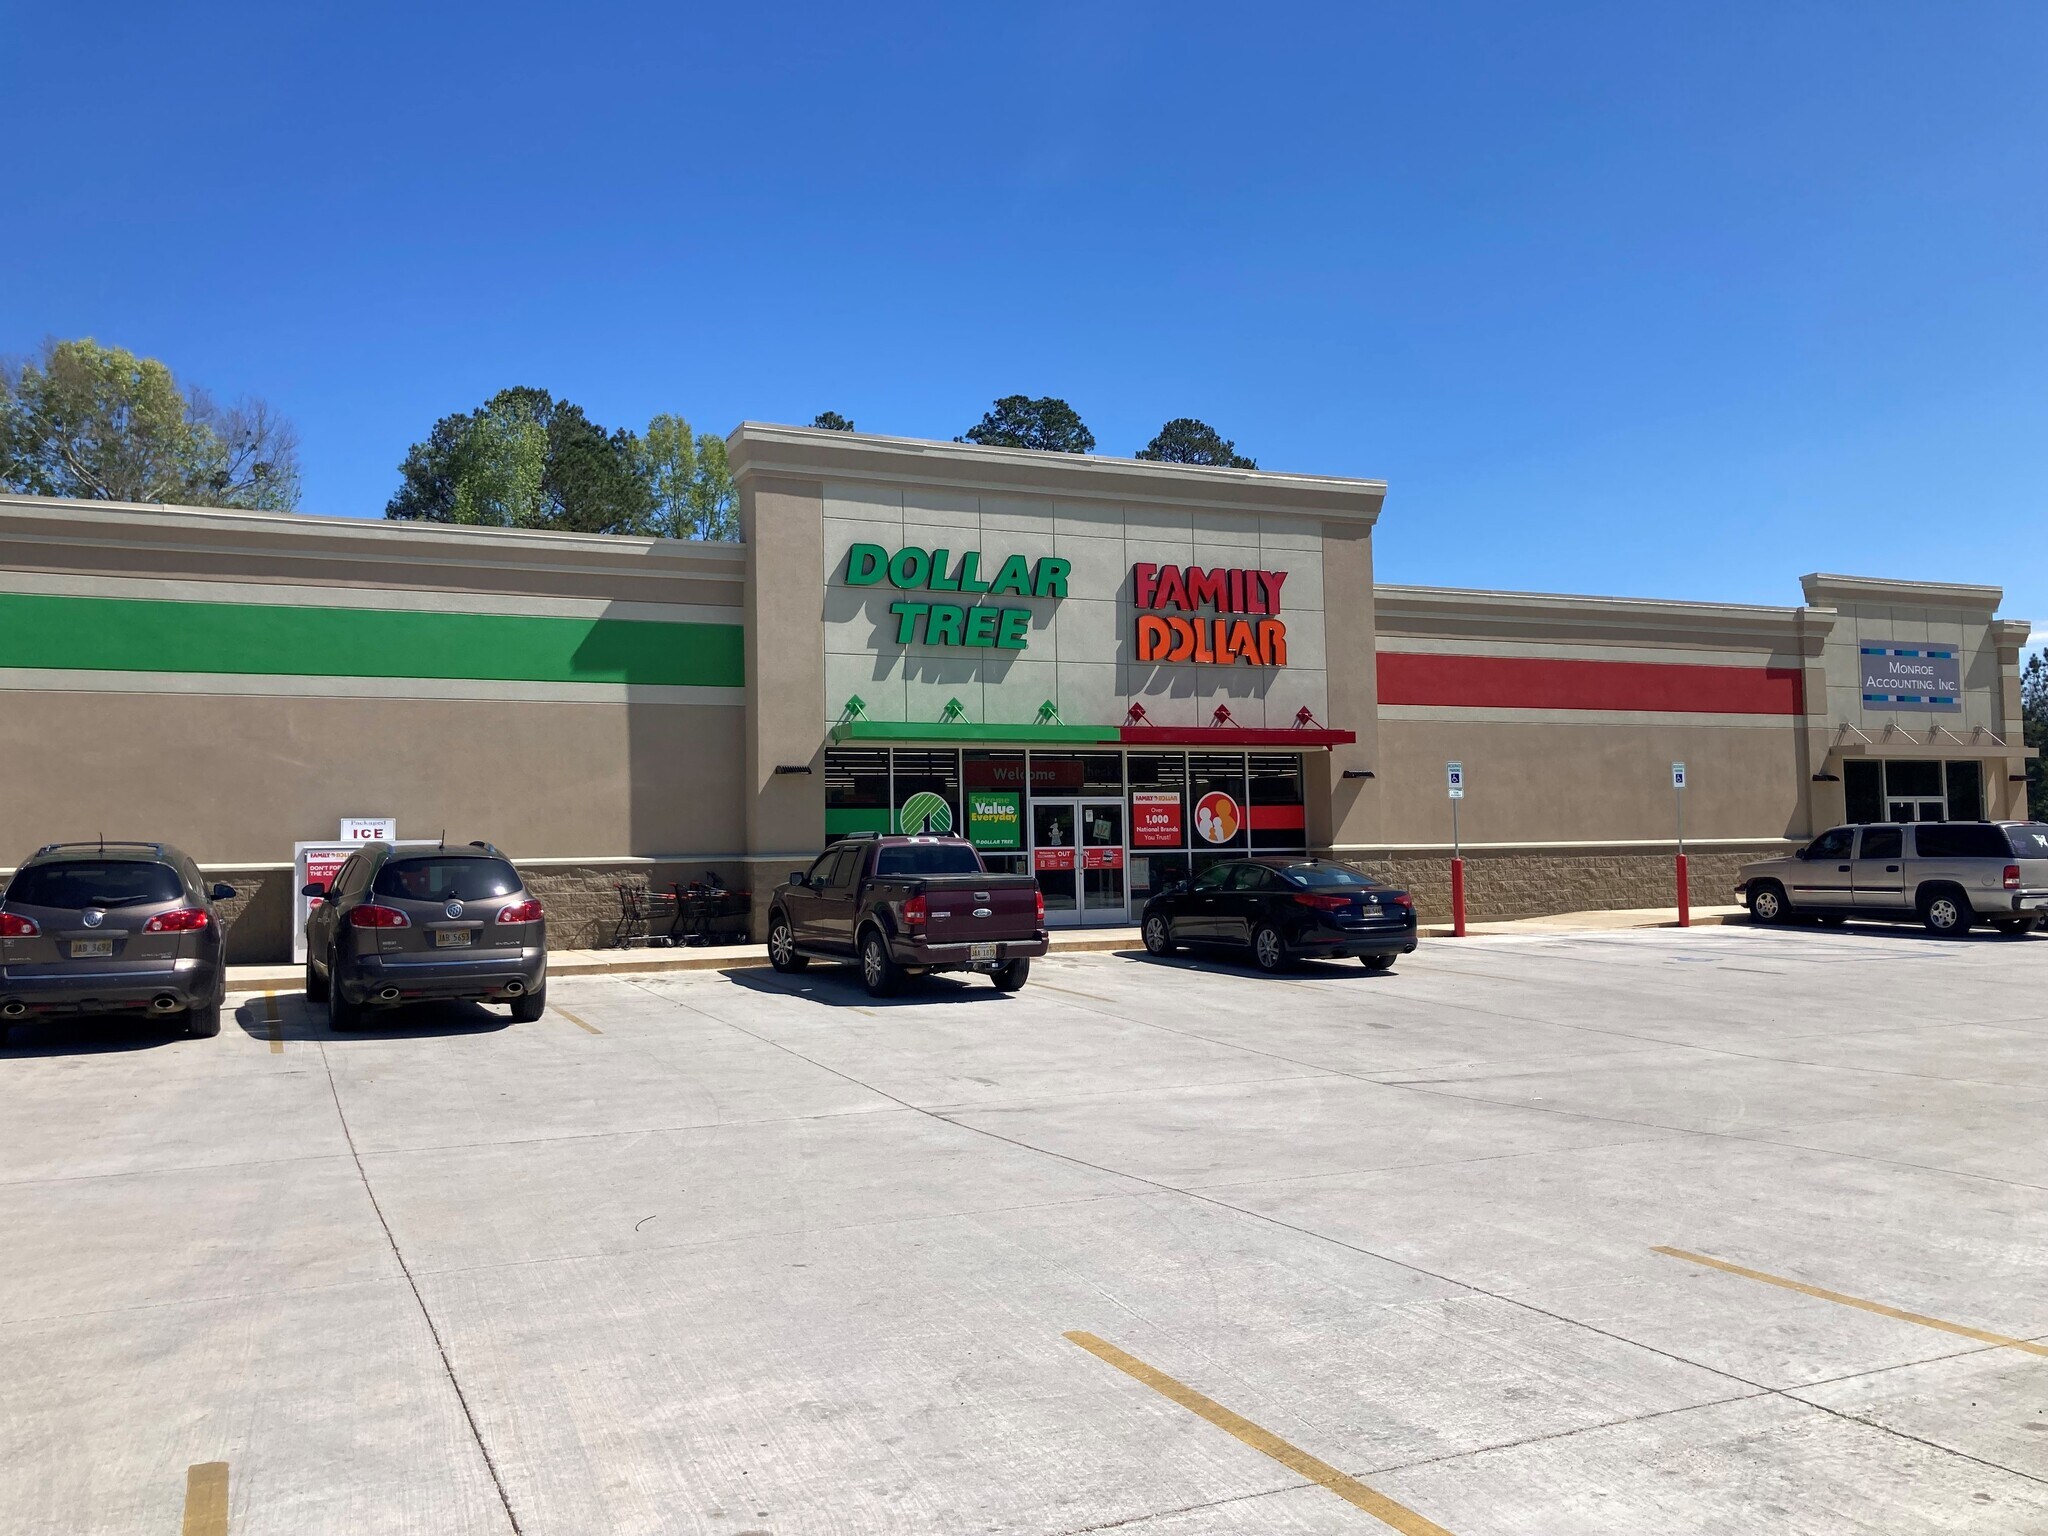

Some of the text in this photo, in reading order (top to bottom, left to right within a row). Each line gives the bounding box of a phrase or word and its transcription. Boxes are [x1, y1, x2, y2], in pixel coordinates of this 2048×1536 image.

[845, 543, 1072, 597] DOLLAR
[1134, 563, 1288, 615] FAMILY
[890, 602, 1032, 649] TREE
[1135, 614, 1287, 666] DOLLAR
[993, 767, 1056, 780] Welcome
[971, 796, 1009, 804] Extreme
[975, 802, 1015, 815] Value
[971, 812, 1017, 823] Everyday
[1145, 814, 1169, 825] 1,000
[353, 828, 384, 839] ICE
